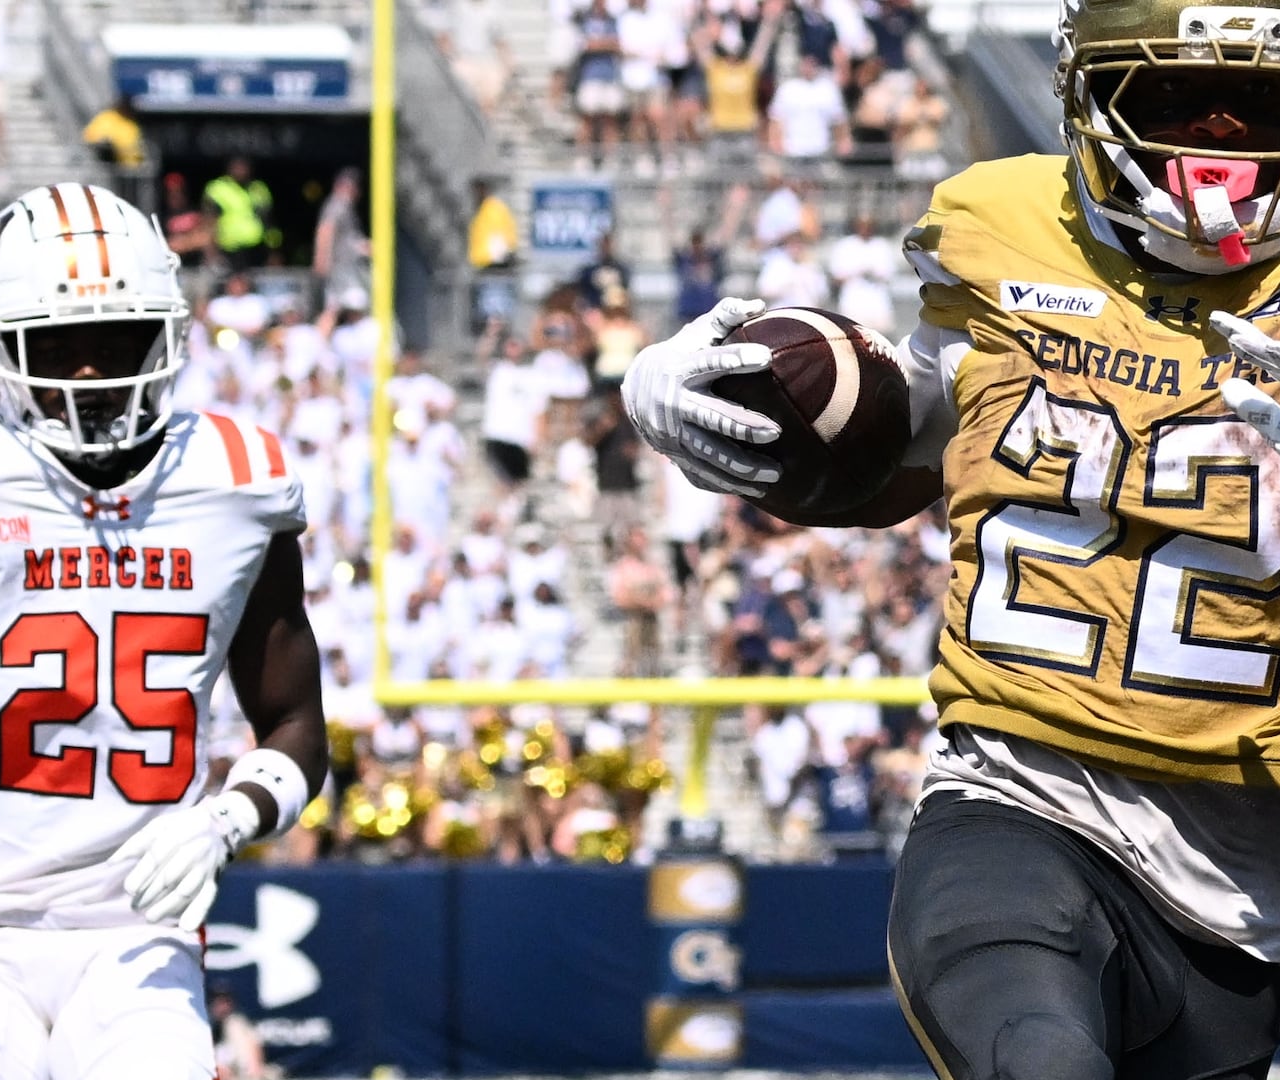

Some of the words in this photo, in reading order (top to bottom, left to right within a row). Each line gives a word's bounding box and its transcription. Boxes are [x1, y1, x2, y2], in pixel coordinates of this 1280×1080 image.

[1220, 17, 1256, 30] ACC
[1036, 292, 1094, 312] Veritiv
[23, 547, 193, 590] MERCER
